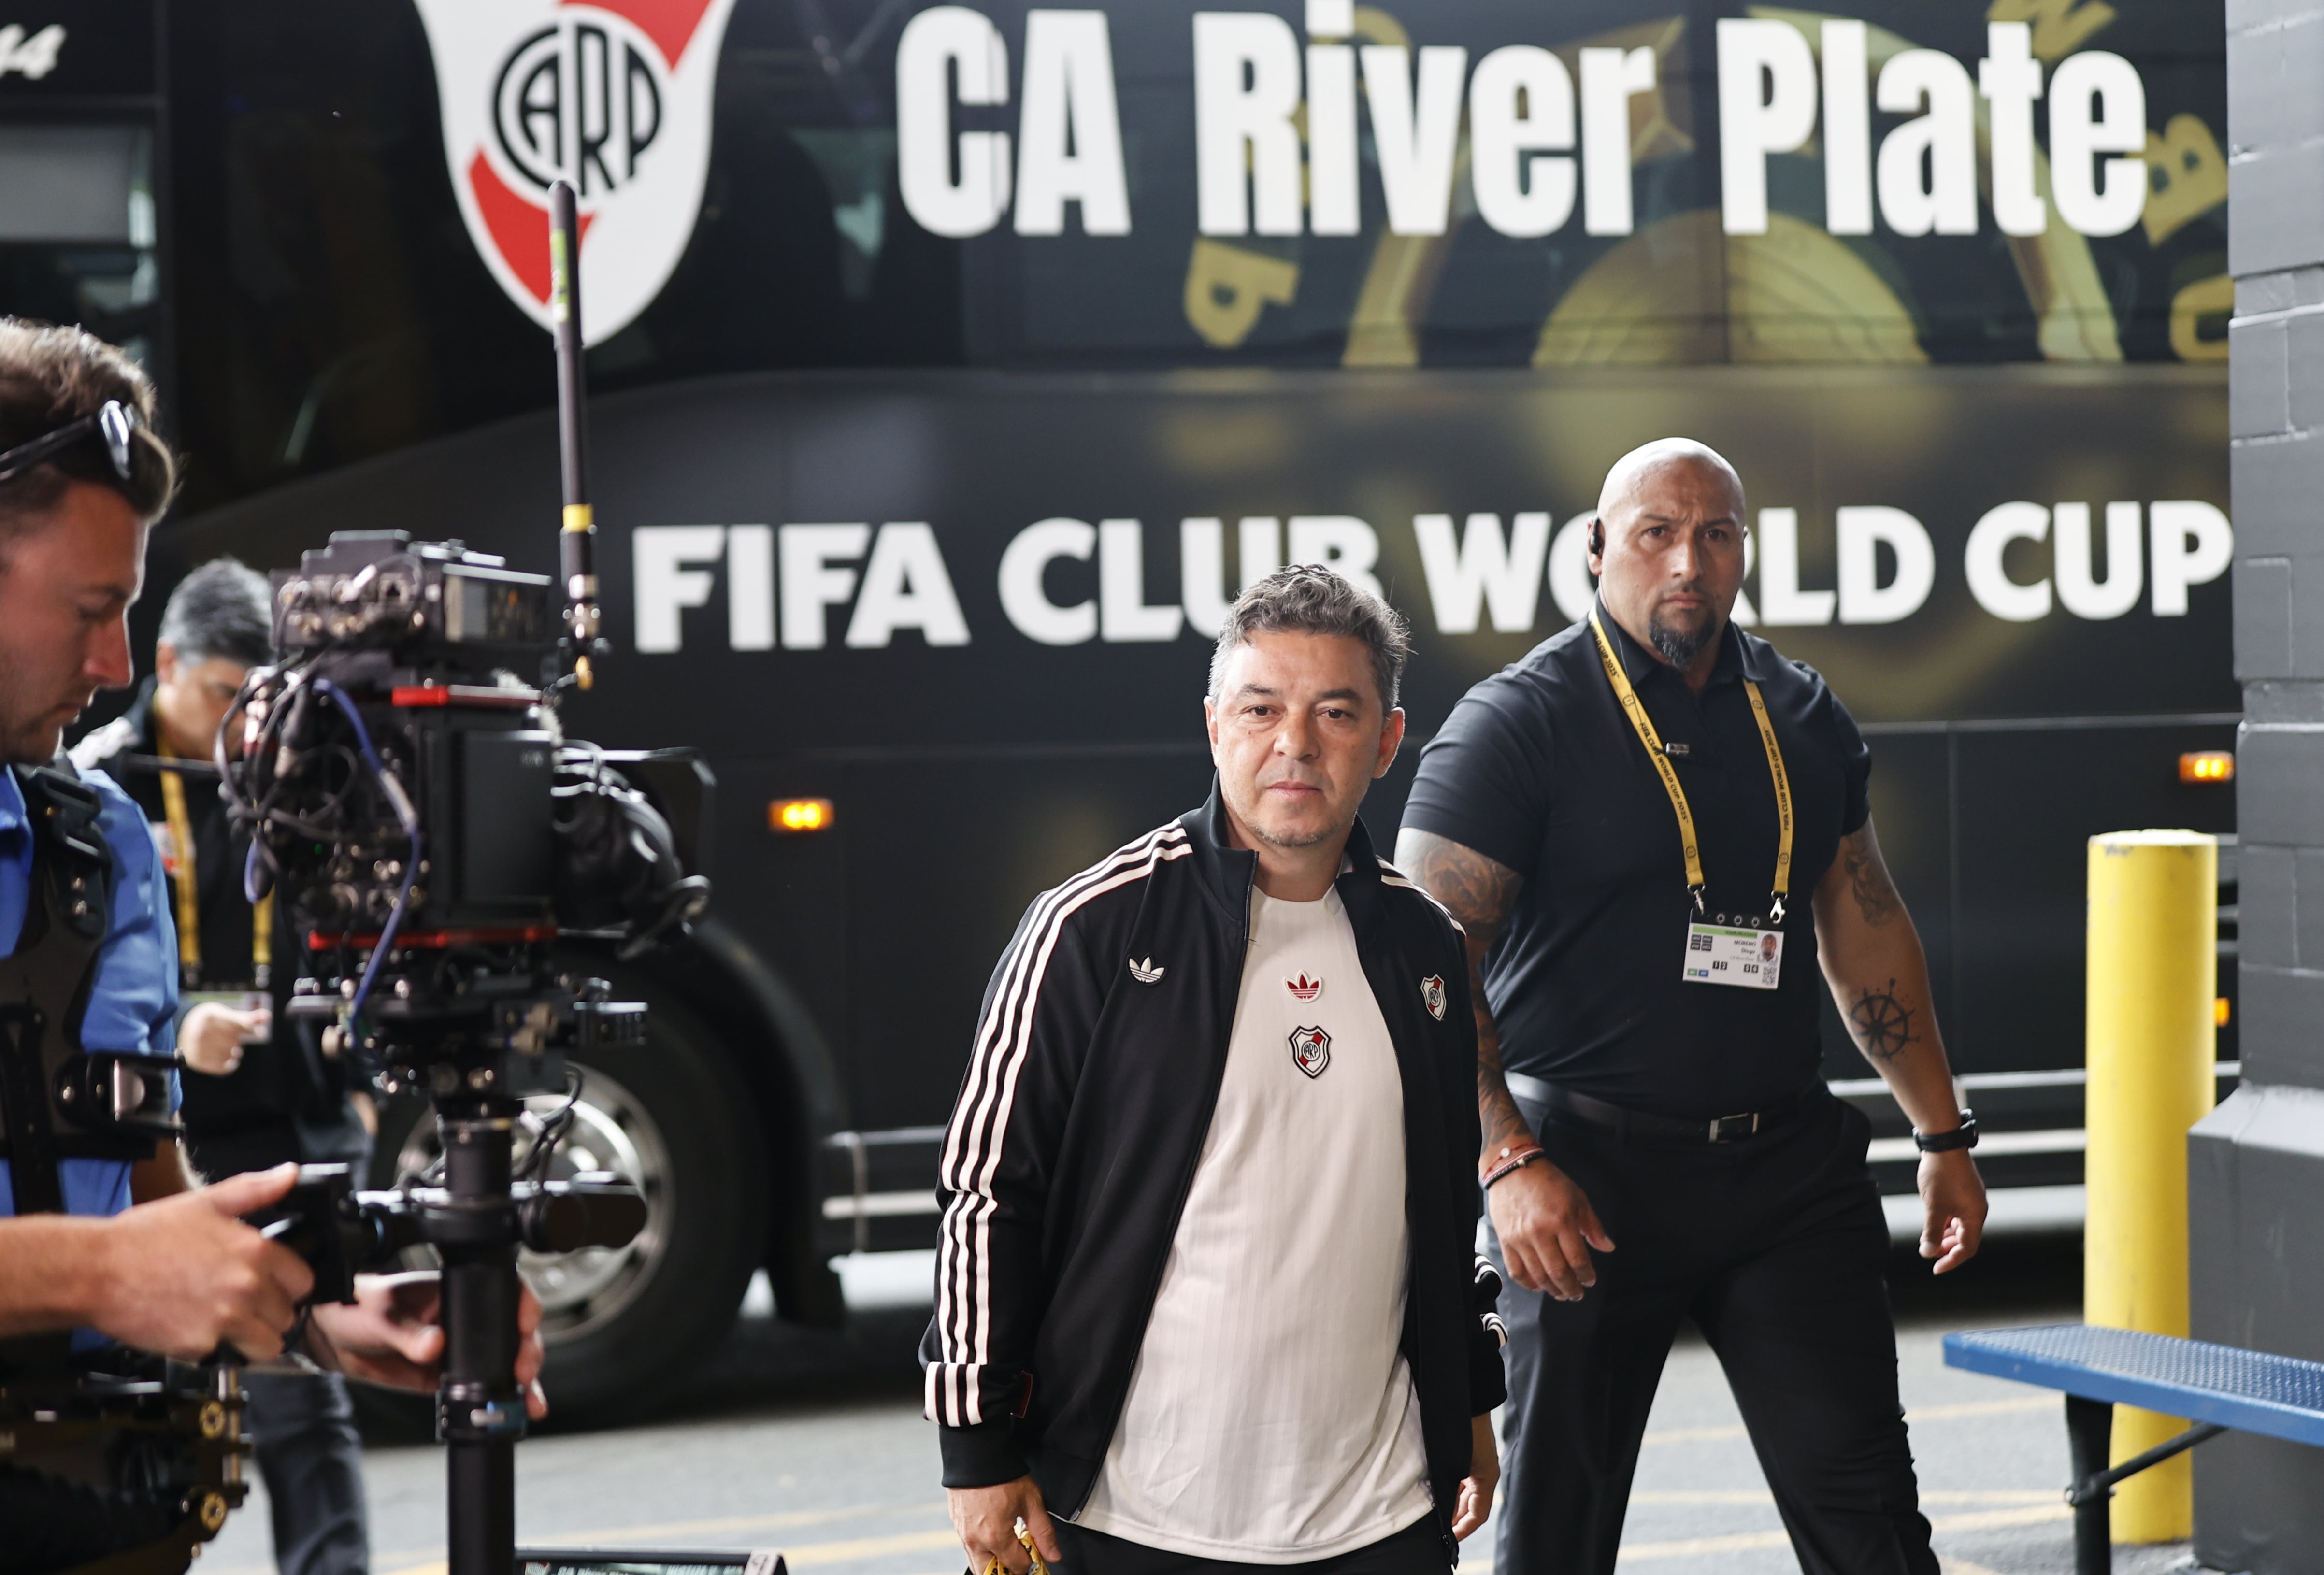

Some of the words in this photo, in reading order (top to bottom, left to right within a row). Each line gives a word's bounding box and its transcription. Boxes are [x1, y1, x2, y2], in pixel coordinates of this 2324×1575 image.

[492, 24, 661, 197] CARP
[896, 6, 1132, 237] CA
[1193, 0, 1656, 237] River
[1717, 18, 2148, 237] Plate
[633, 522, 969, 652] FIFA
[1413, 506, 1936, 634] WLD
[1965, 501, 2234, 621] CUP
[1658, 757, 1673, 783] WORLD
[1670, 783, 1680, 800] CUP
[1303, 1042, 1319, 1060] CARP
